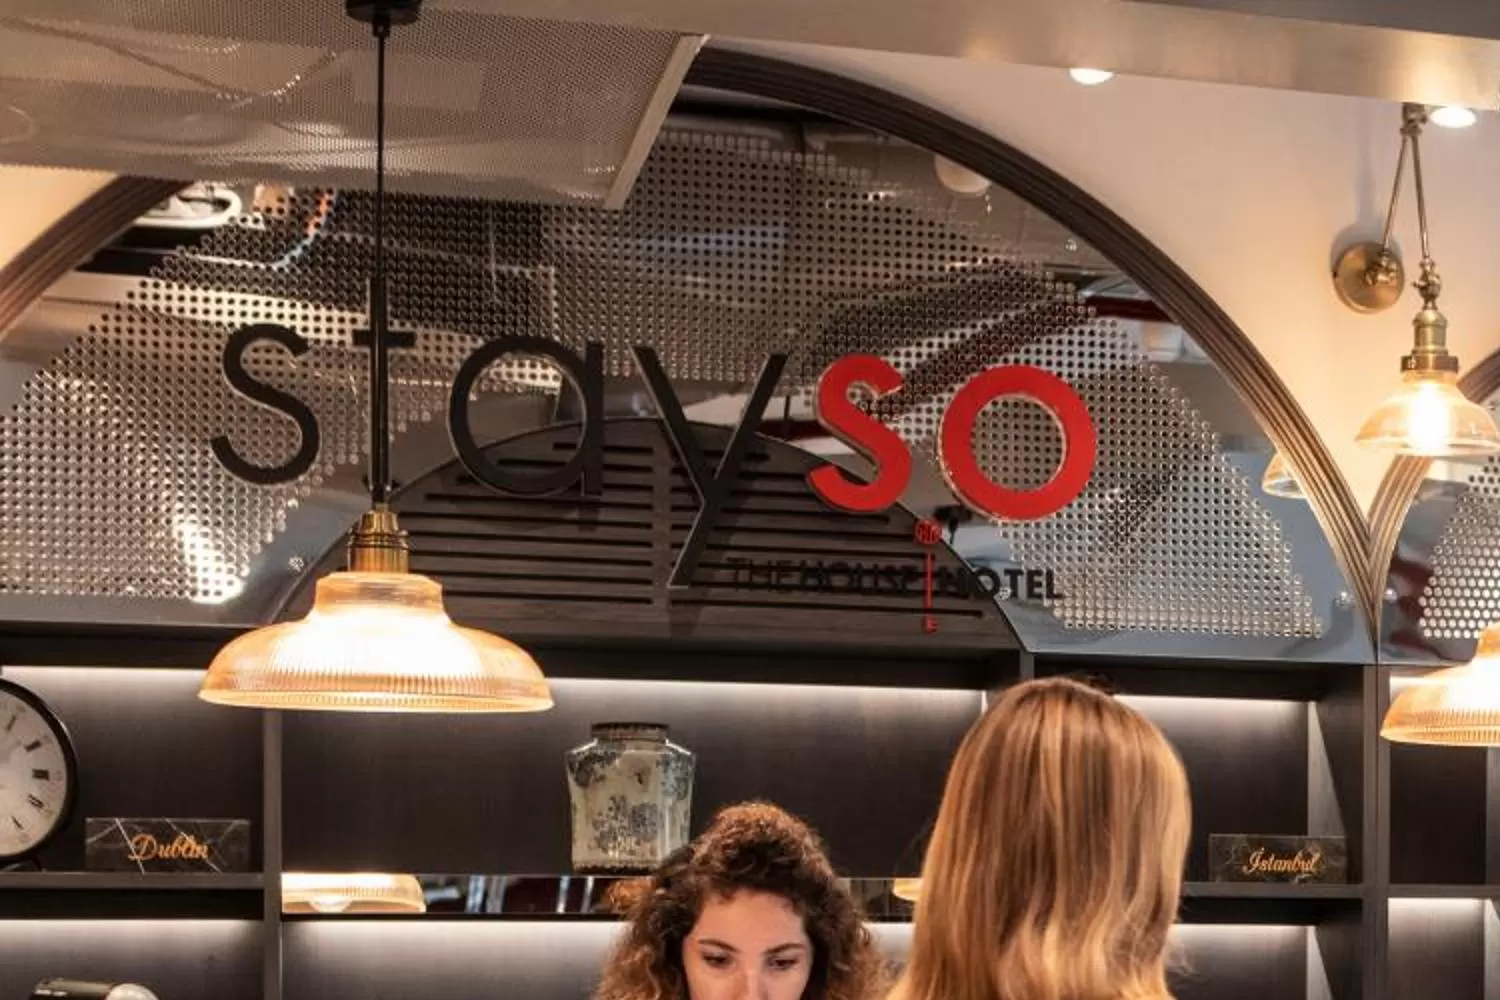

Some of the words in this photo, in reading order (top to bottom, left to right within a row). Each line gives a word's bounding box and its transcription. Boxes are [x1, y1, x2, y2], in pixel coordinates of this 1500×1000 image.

[726, 557, 792, 593] THE
[940, 566, 1063, 600] HOTEL
[128, 833, 209, 861] Dublin
